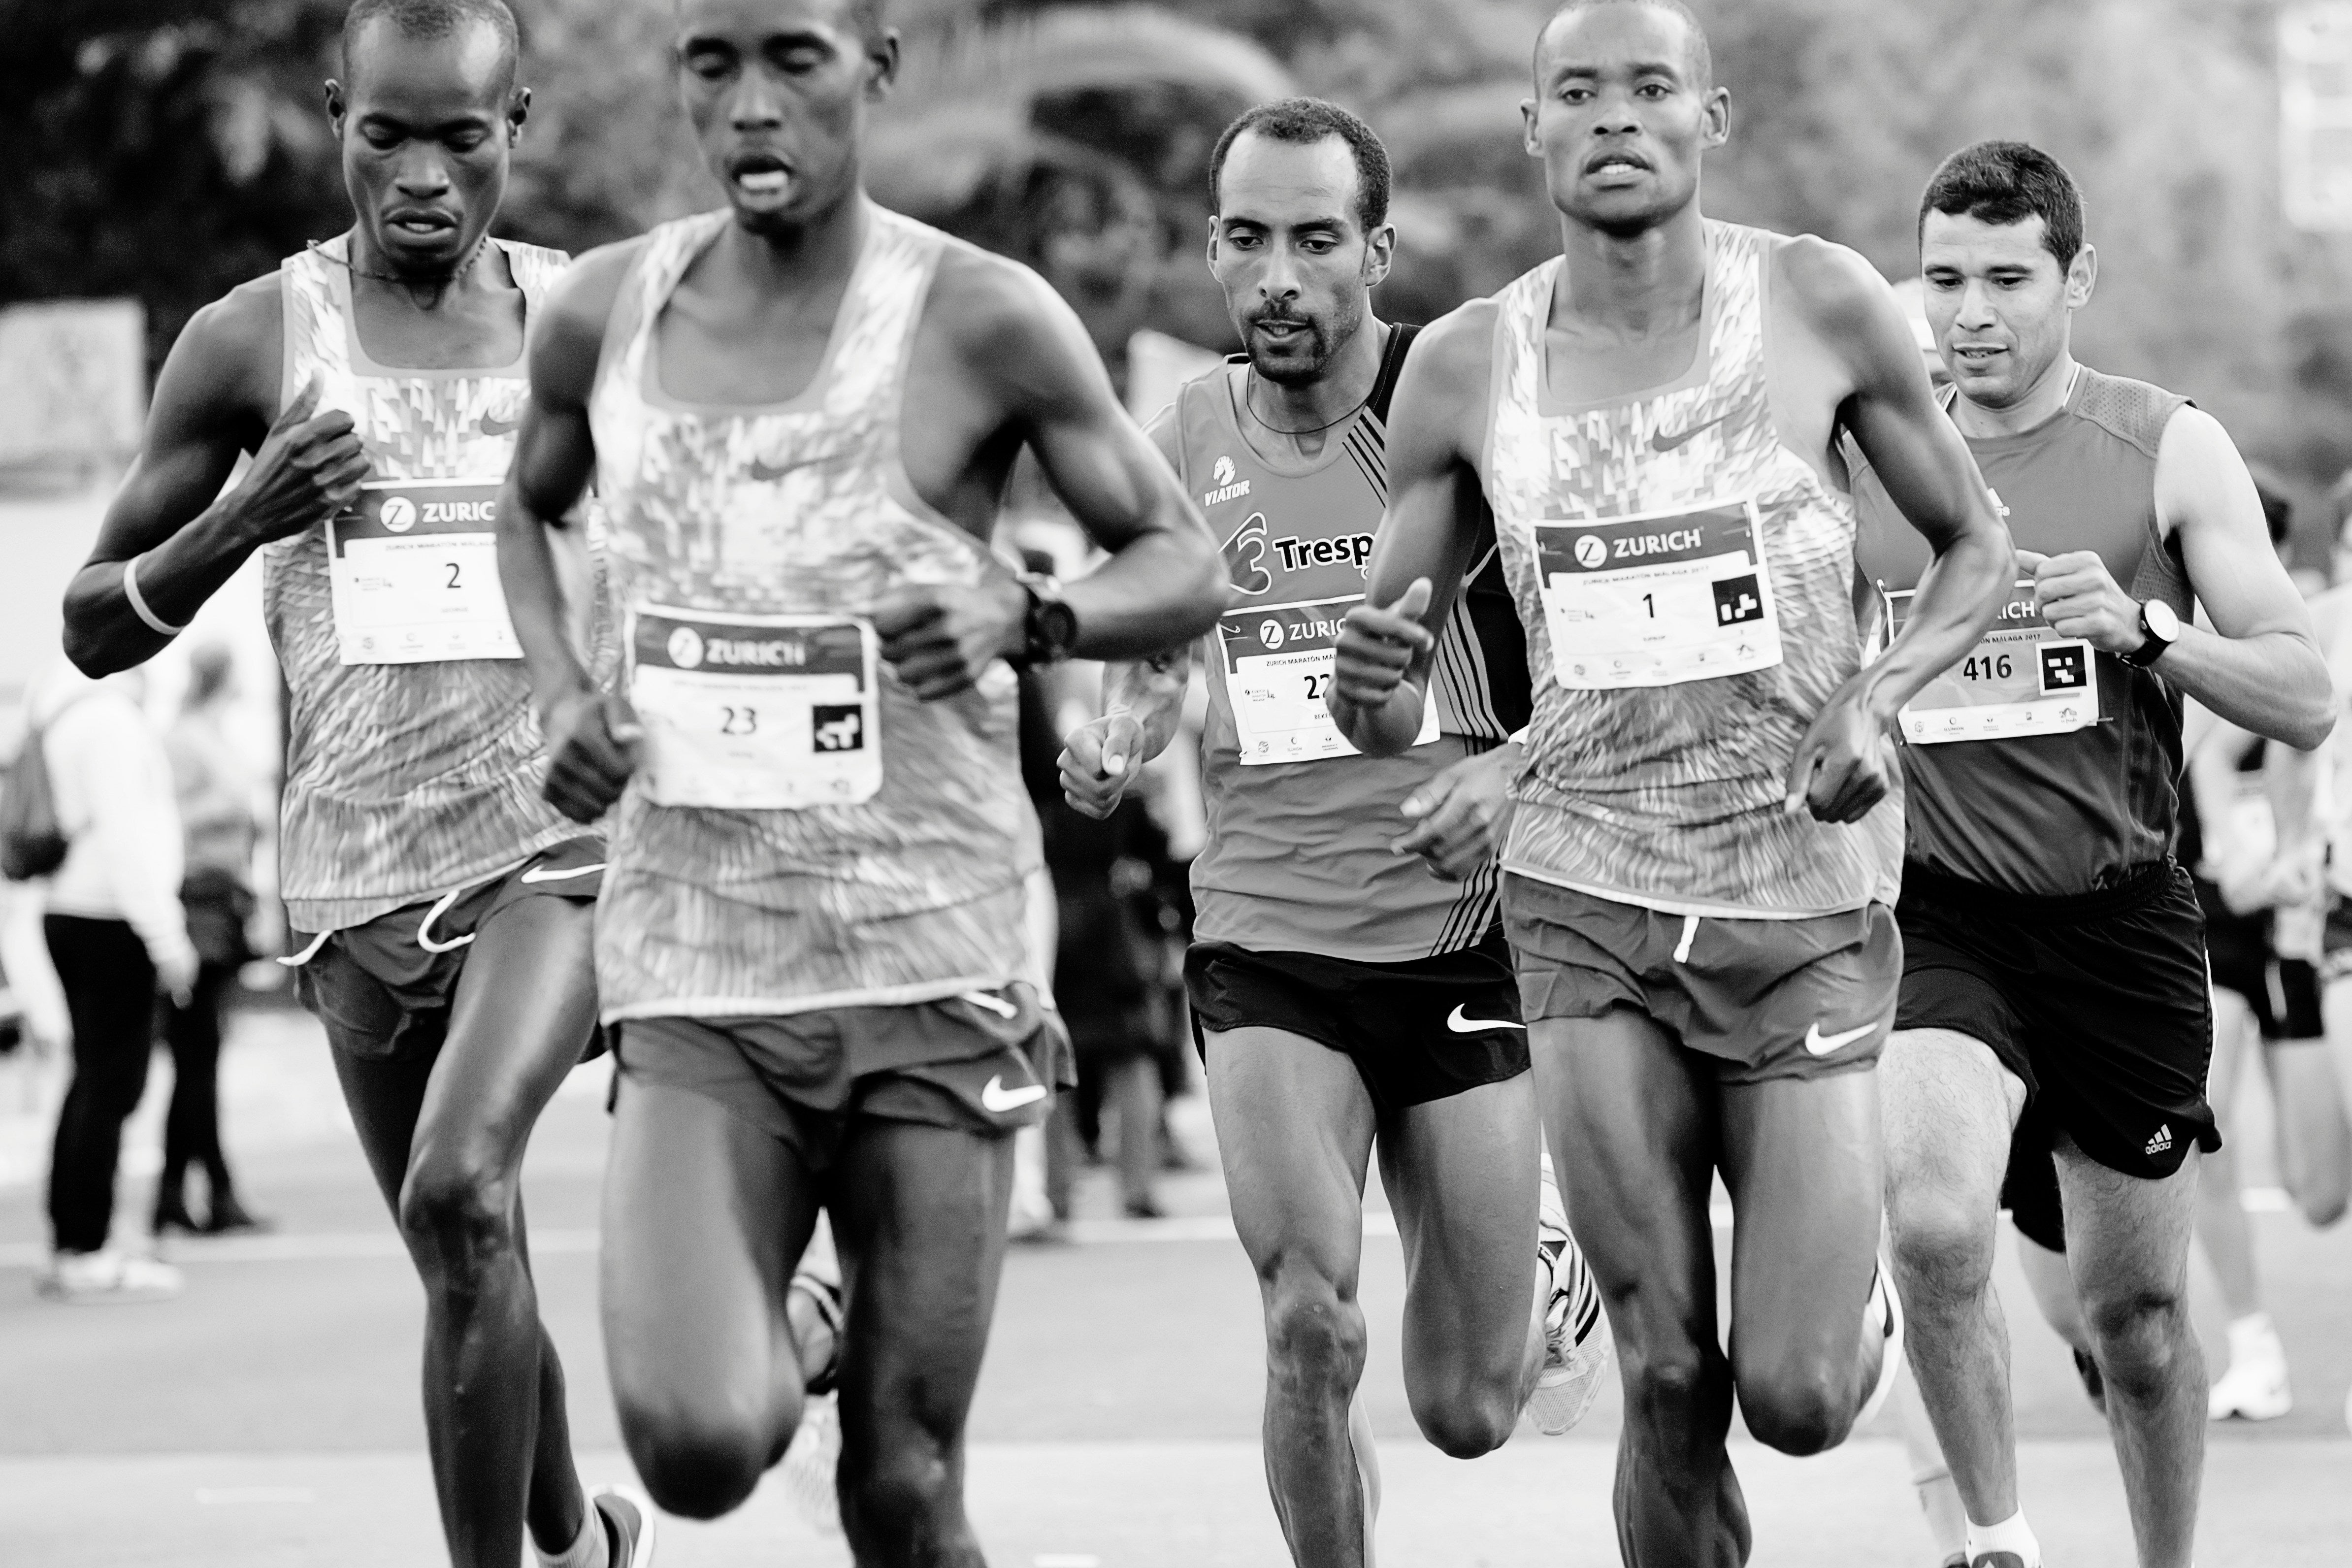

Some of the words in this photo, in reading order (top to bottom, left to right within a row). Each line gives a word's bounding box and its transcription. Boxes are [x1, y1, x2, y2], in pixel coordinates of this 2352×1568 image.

[1205, 480, 1250, 507] VIATOR
[1274, 534, 1374, 570] Tresp
[1613, 528, 1701, 558] ZURICH
[445, 562, 461, 589] 2
[1642, 593, 1655, 619] 1
[1997, 600, 2036, 619] ICH
[706, 638, 806, 665] ZURICH
[1962, 654, 2012, 681] 416
[721, 706, 757, 736] 23
